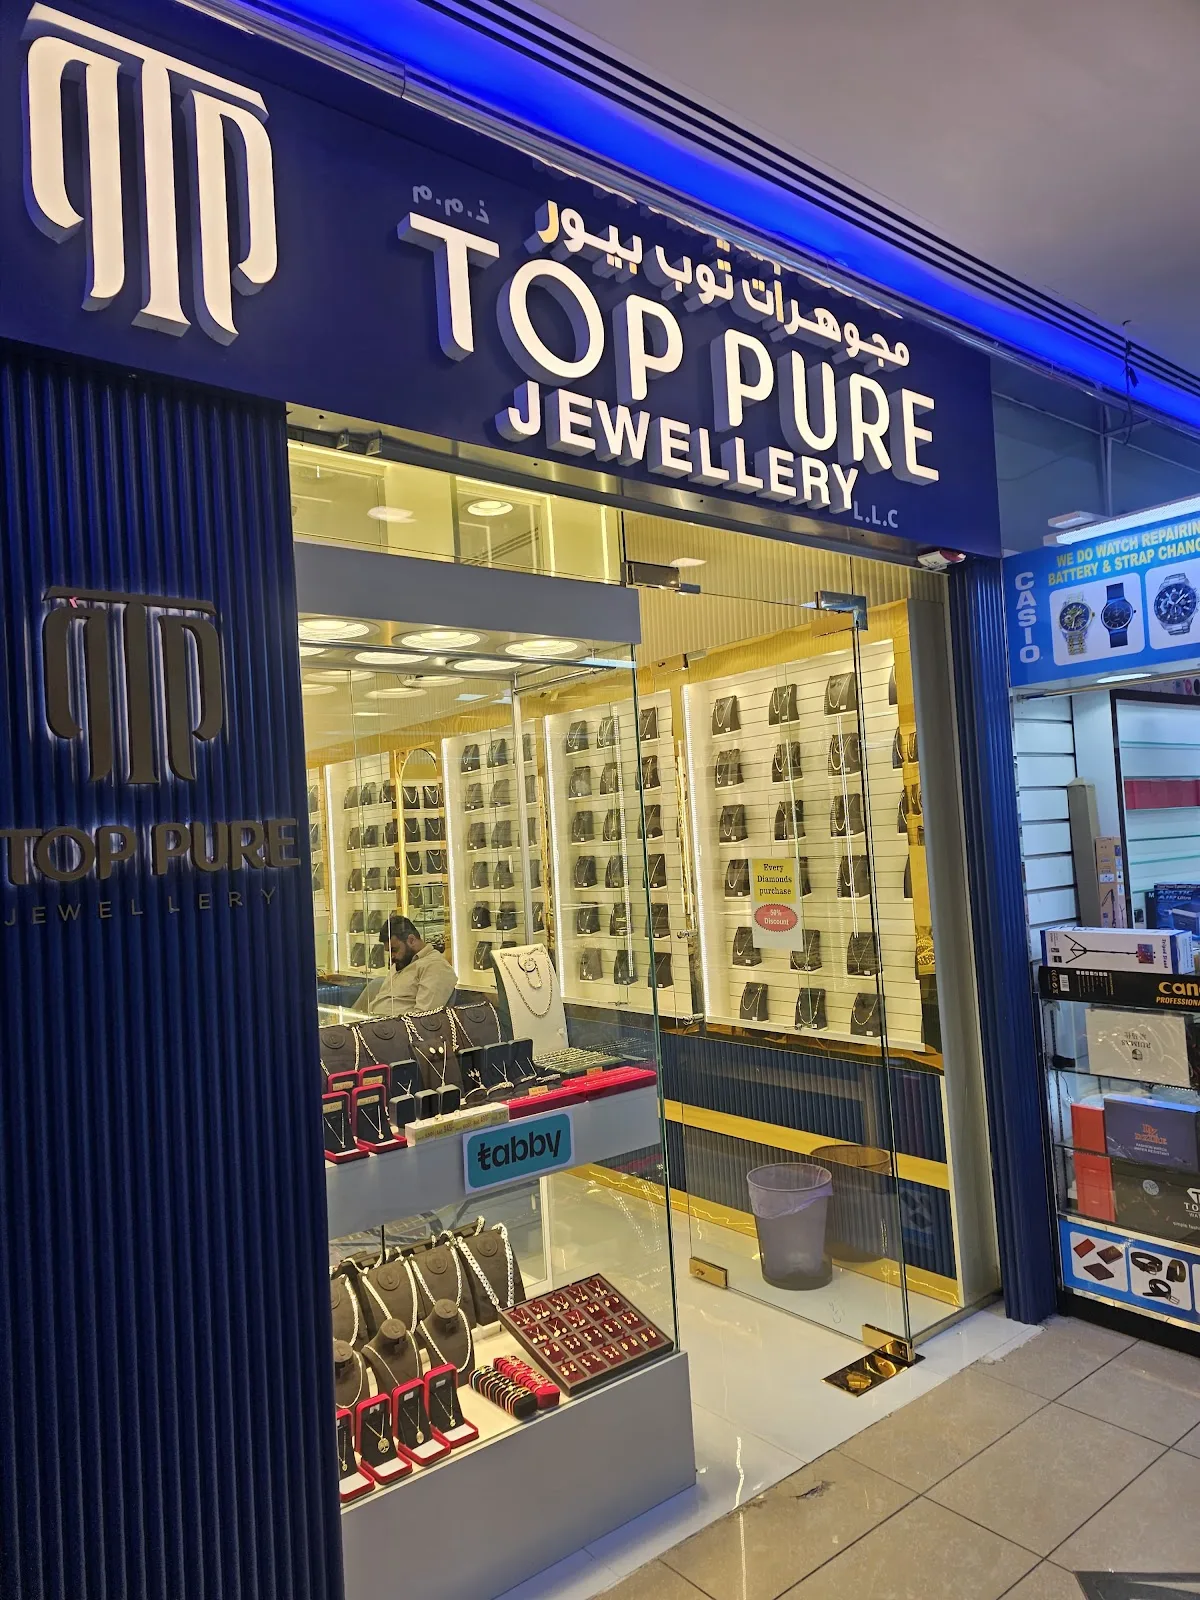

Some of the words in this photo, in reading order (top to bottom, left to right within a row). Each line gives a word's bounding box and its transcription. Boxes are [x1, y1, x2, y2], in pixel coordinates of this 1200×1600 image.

[537, 200, 643, 274] بيور
[655, 245, 734, 304] توب
[741, 278, 910, 367] مجوهرات
[406, 212, 684, 401] TOP
[722, 328, 939, 482] PURE
[507, 380, 859, 511] JEWELLERY
[853, 500, 899, 529] L.L.C
[1048, 562, 1098, 586] BATTERY
[1102, 559, 1112, 574] &
[1114, 548, 1155, 571] STRAP
[1056, 552, 1074, 567] WE
[1077, 547, 1093, 563] DO
[1096, 535, 1138, 558] WATCH
[1014, 571, 1041, 664] CASIO
[0, 825, 138, 886] TOP
[151, 817, 301, 876] PURE
[763, 863, 784, 873] Every
[757, 875, 793, 884] Diamonds
[759, 887, 792, 896] purchase
[4, 887, 277, 926] JEWELLERY
[764, 917, 790, 926] Discount
[1158, 981, 1200, 996] Can
[477, 1129, 561, 1171] tabby
